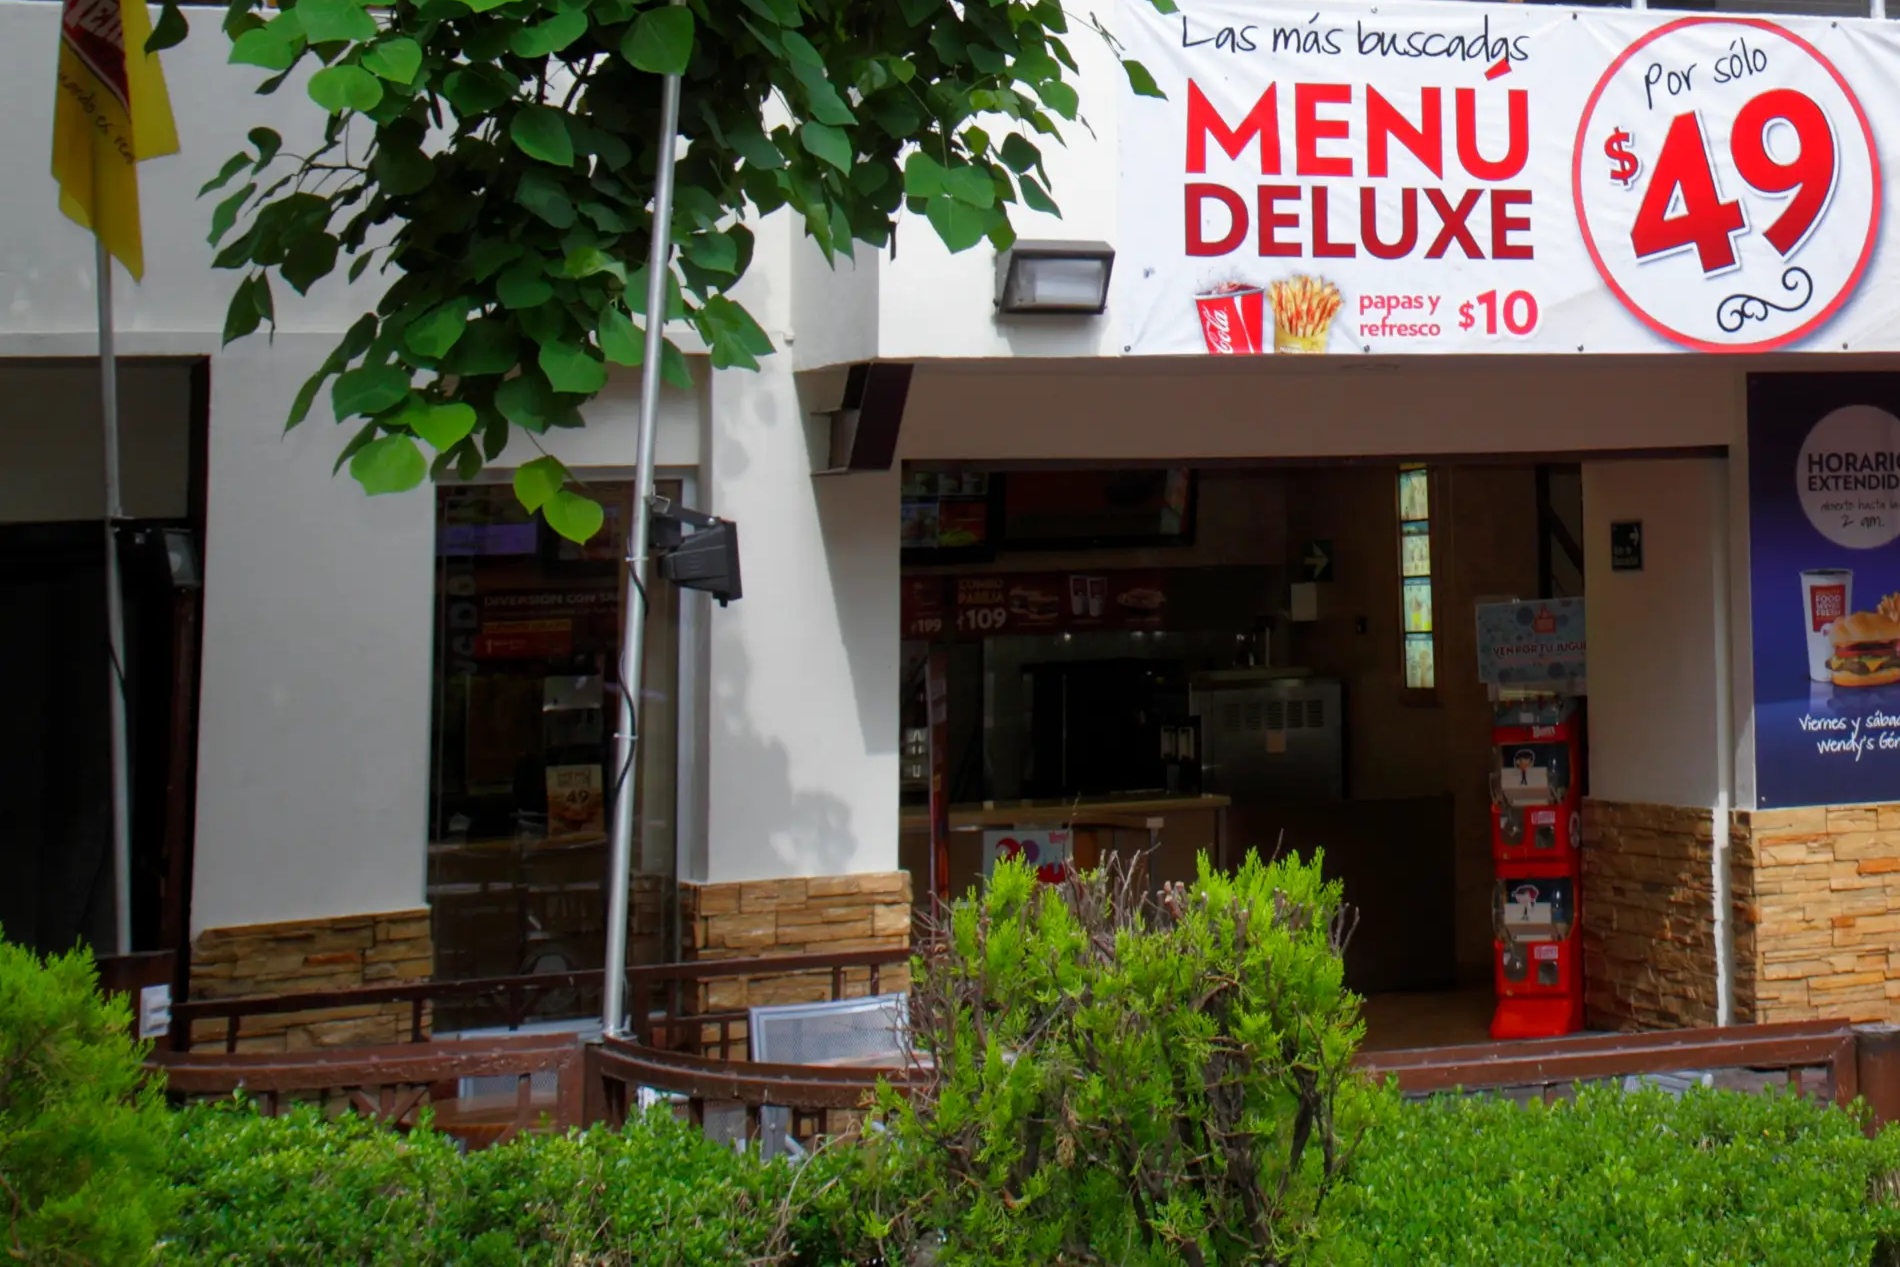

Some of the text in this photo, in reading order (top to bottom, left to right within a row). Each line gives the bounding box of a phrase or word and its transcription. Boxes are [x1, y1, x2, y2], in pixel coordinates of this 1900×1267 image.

[1182, 12, 1530, 63] Las más buscadas
[1713, 37, 1767, 84] sólo
[1185, 58, 1530, 181] MENÚ
[1604, 88, 1838, 274] $49
[1184, 182, 1534, 260] DELUXE
[1359, 294, 1441, 316] papas y
[1359, 315, 1441, 336] refresco
[1458, 289, 1539, 336] $10
[1841, 514, 1854, 529] 2
[1799, 714, 1847, 731] Viernes
[1851, 717, 1861, 735] y
